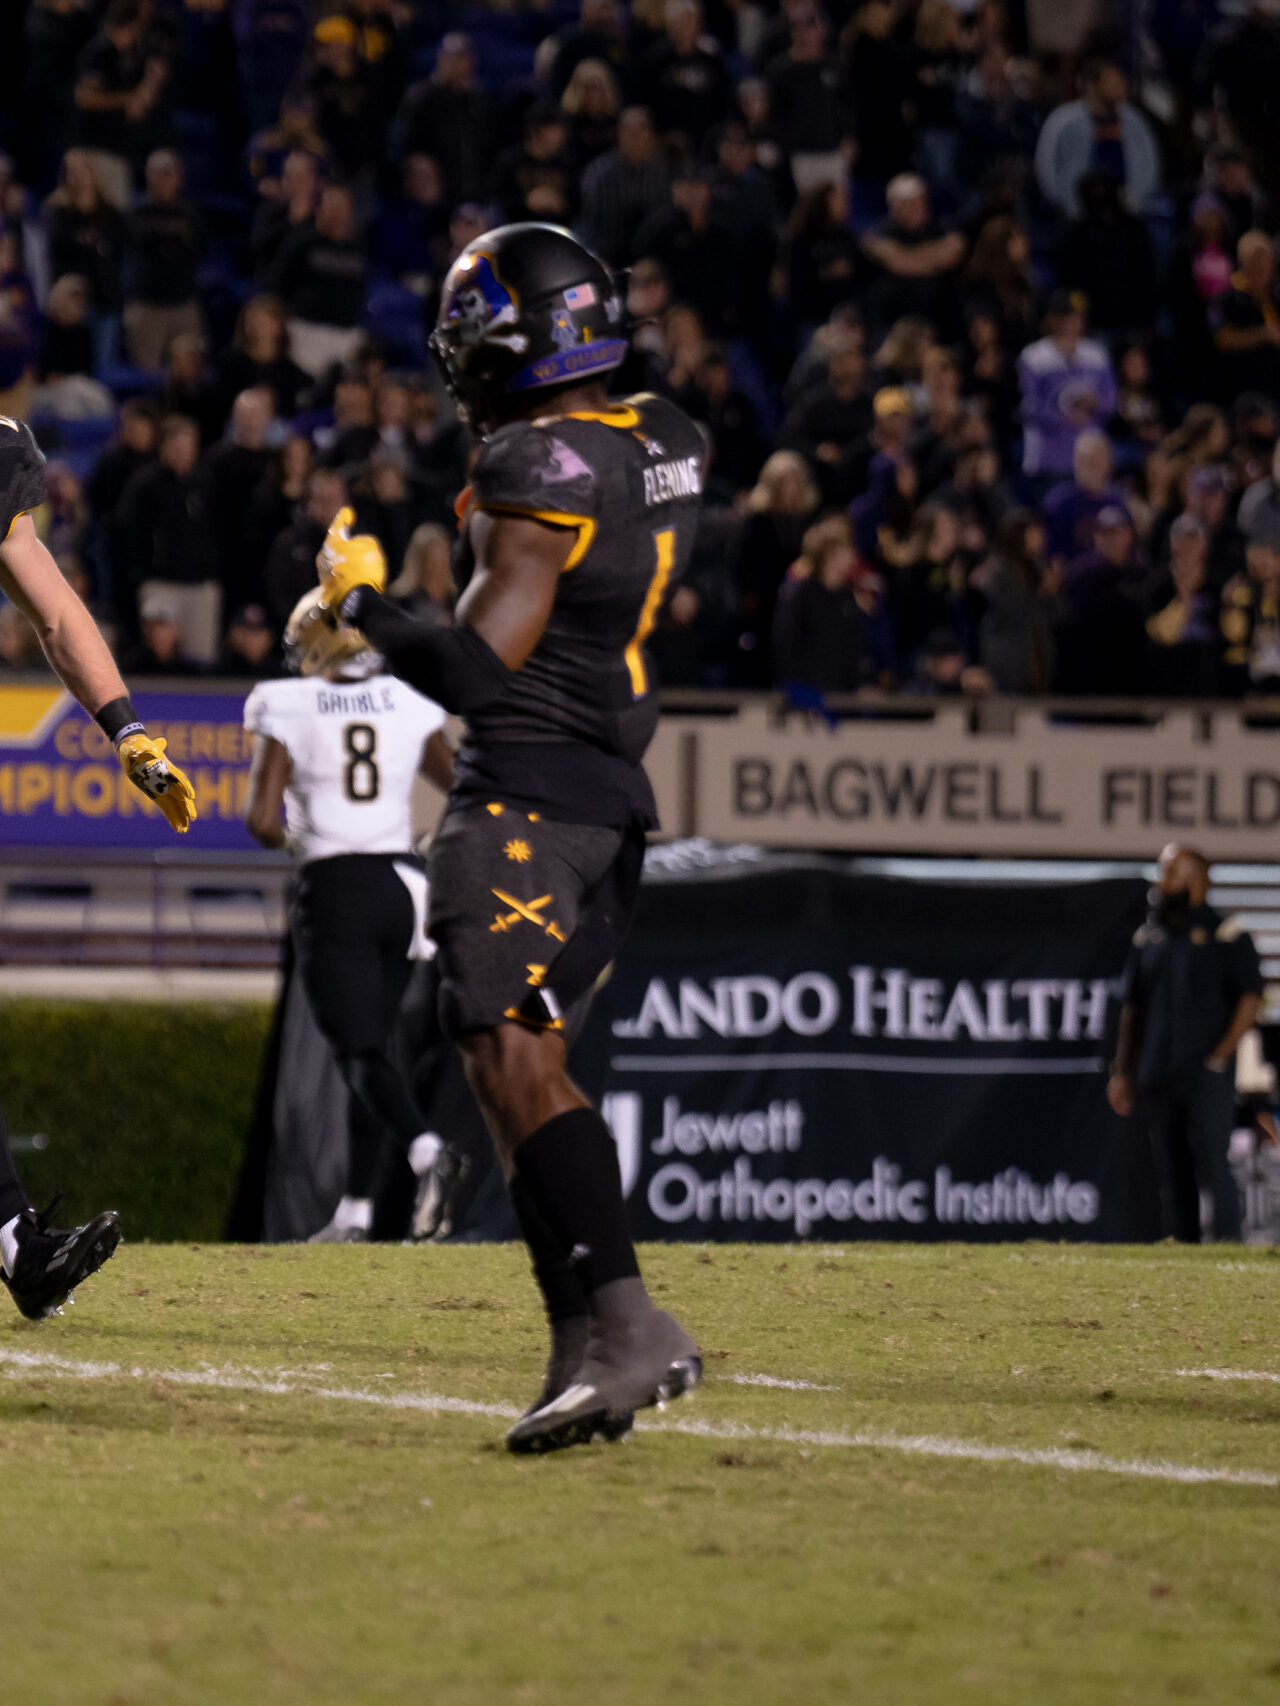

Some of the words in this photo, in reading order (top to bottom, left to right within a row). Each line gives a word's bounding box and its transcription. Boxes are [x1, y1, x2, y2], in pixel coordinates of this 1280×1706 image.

[643, 457, 702, 506] FLEMING
[623, 524, 675, 702] 1
[343, 720, 380, 804] 8
[733, 757, 1063, 824] BAGWELL
[1101, 766, 1280, 829] FIELD
[849, 964, 1107, 1042] HEALTH
[650, 1093, 805, 1156] Jewett
[646, 1154, 929, 1237] Orthopedic
[934, 1162, 1101, 1225] Institute
